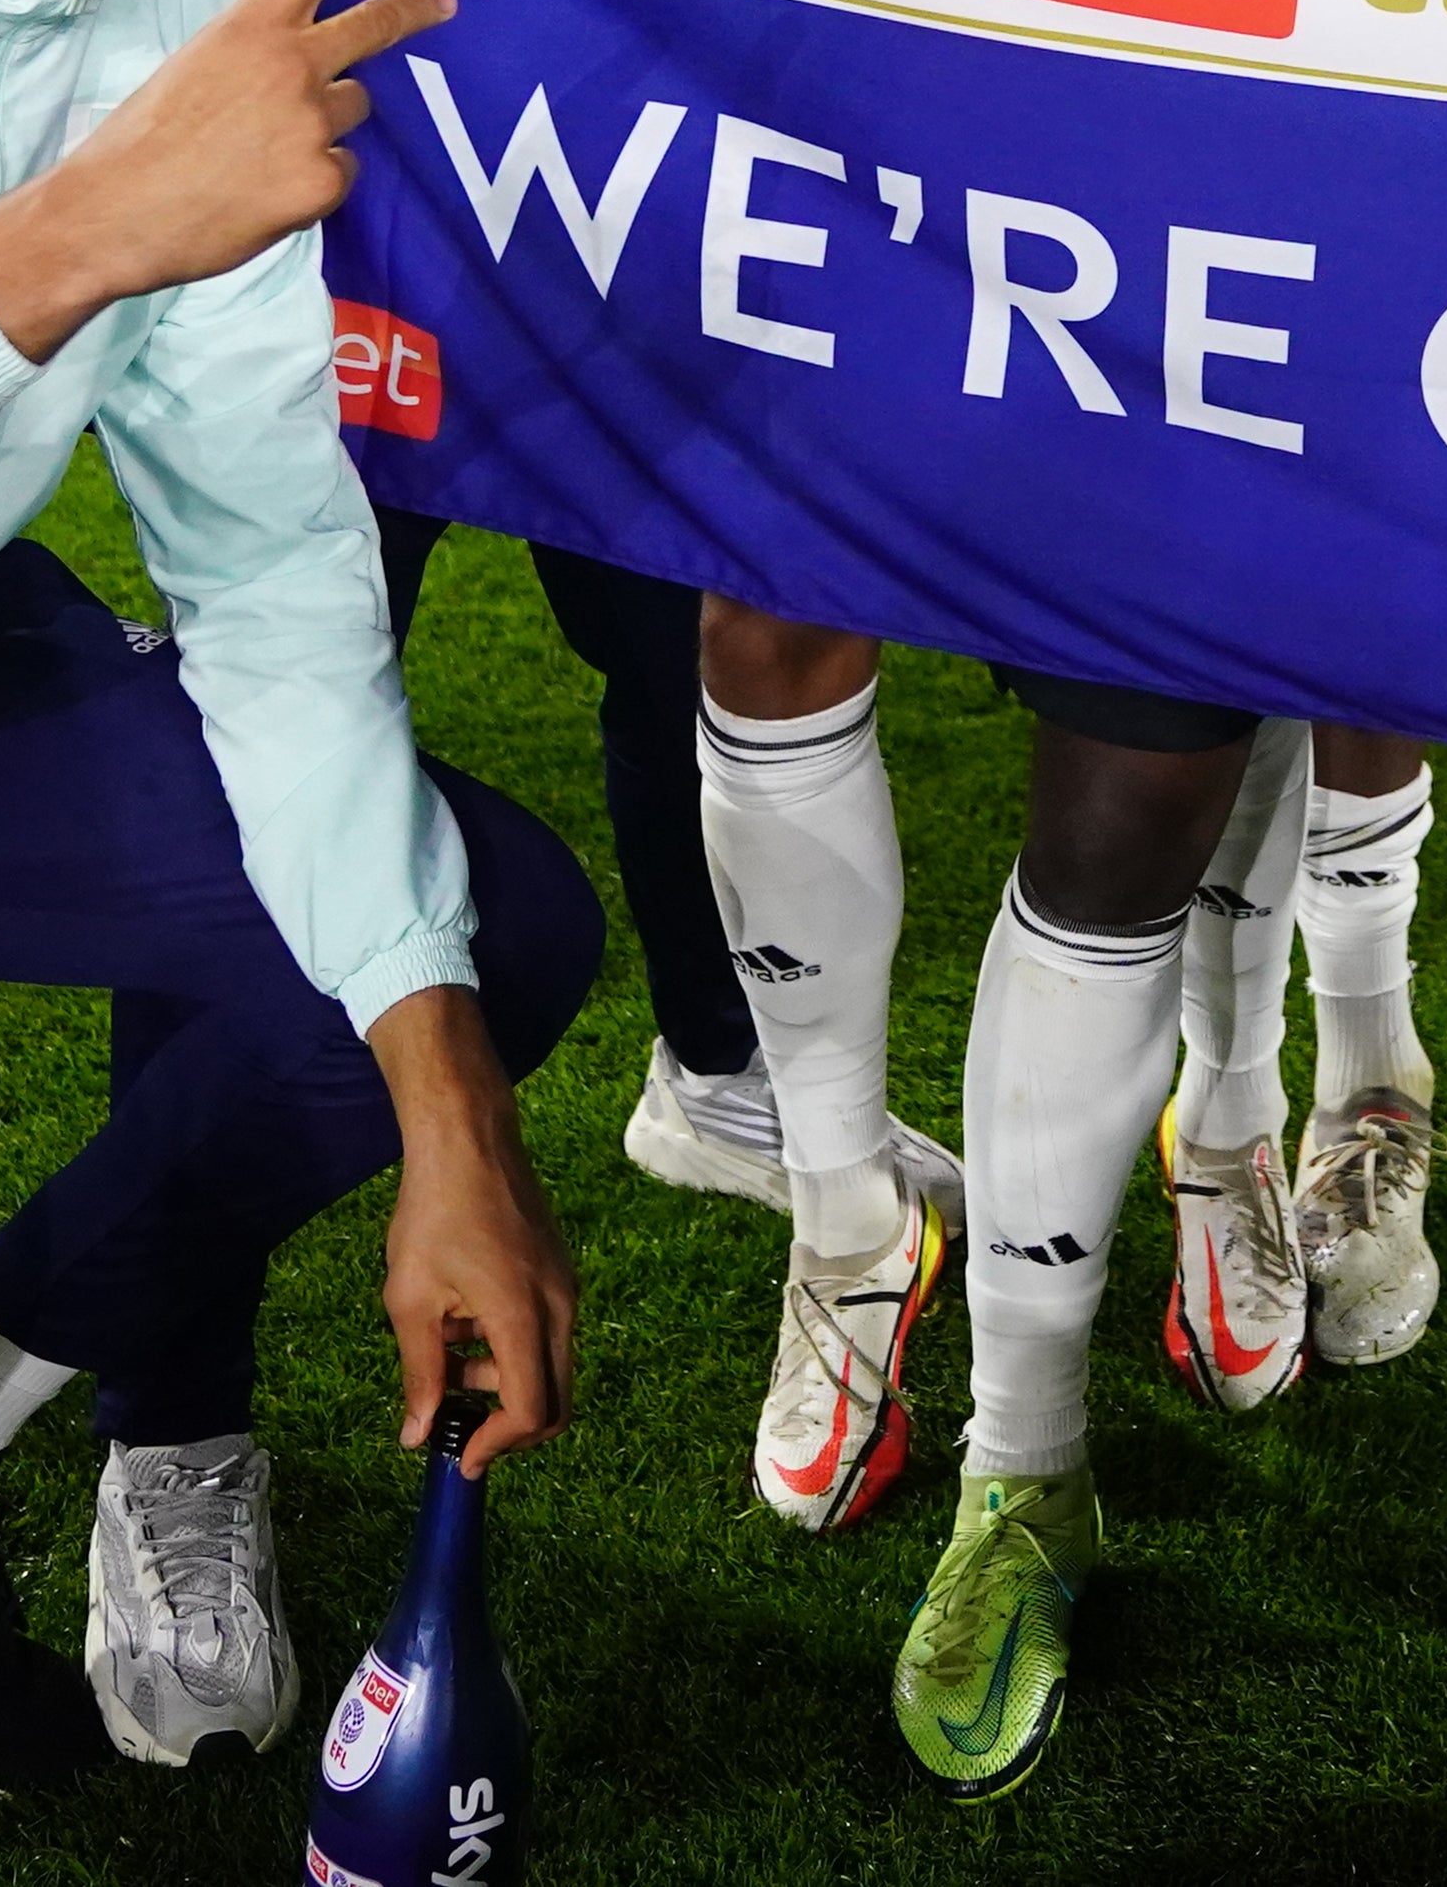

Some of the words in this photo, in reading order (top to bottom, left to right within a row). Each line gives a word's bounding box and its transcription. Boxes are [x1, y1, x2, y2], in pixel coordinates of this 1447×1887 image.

[403, 53, 1318, 456] WE'RE
[331, 332, 422, 406] et
[365, 1675, 395, 1709] bet
[330, 1738, 347, 1770] EFL
